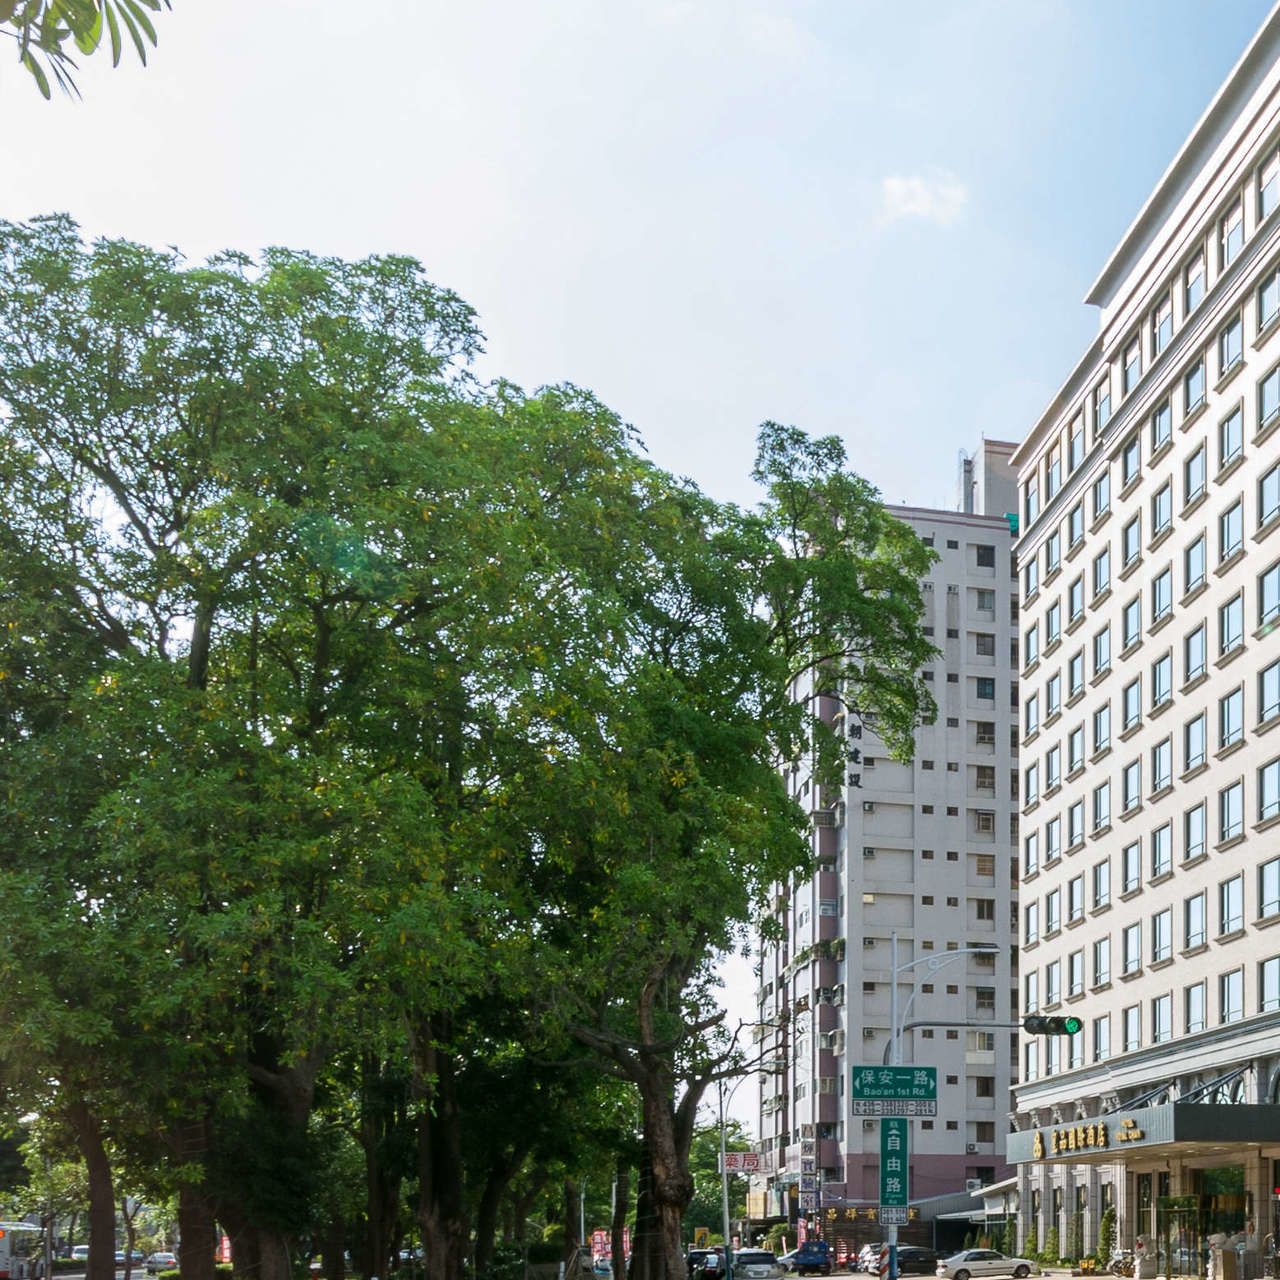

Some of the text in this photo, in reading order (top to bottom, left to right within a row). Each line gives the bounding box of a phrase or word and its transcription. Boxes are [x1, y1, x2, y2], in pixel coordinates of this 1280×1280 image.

[861, 1069, 928, 1086] 保安一路
[864, 1087, 895, 1096] Bao'an
[897, 1087, 910, 1096] 1st
[887, 1135, 901, 1192] 自由路
